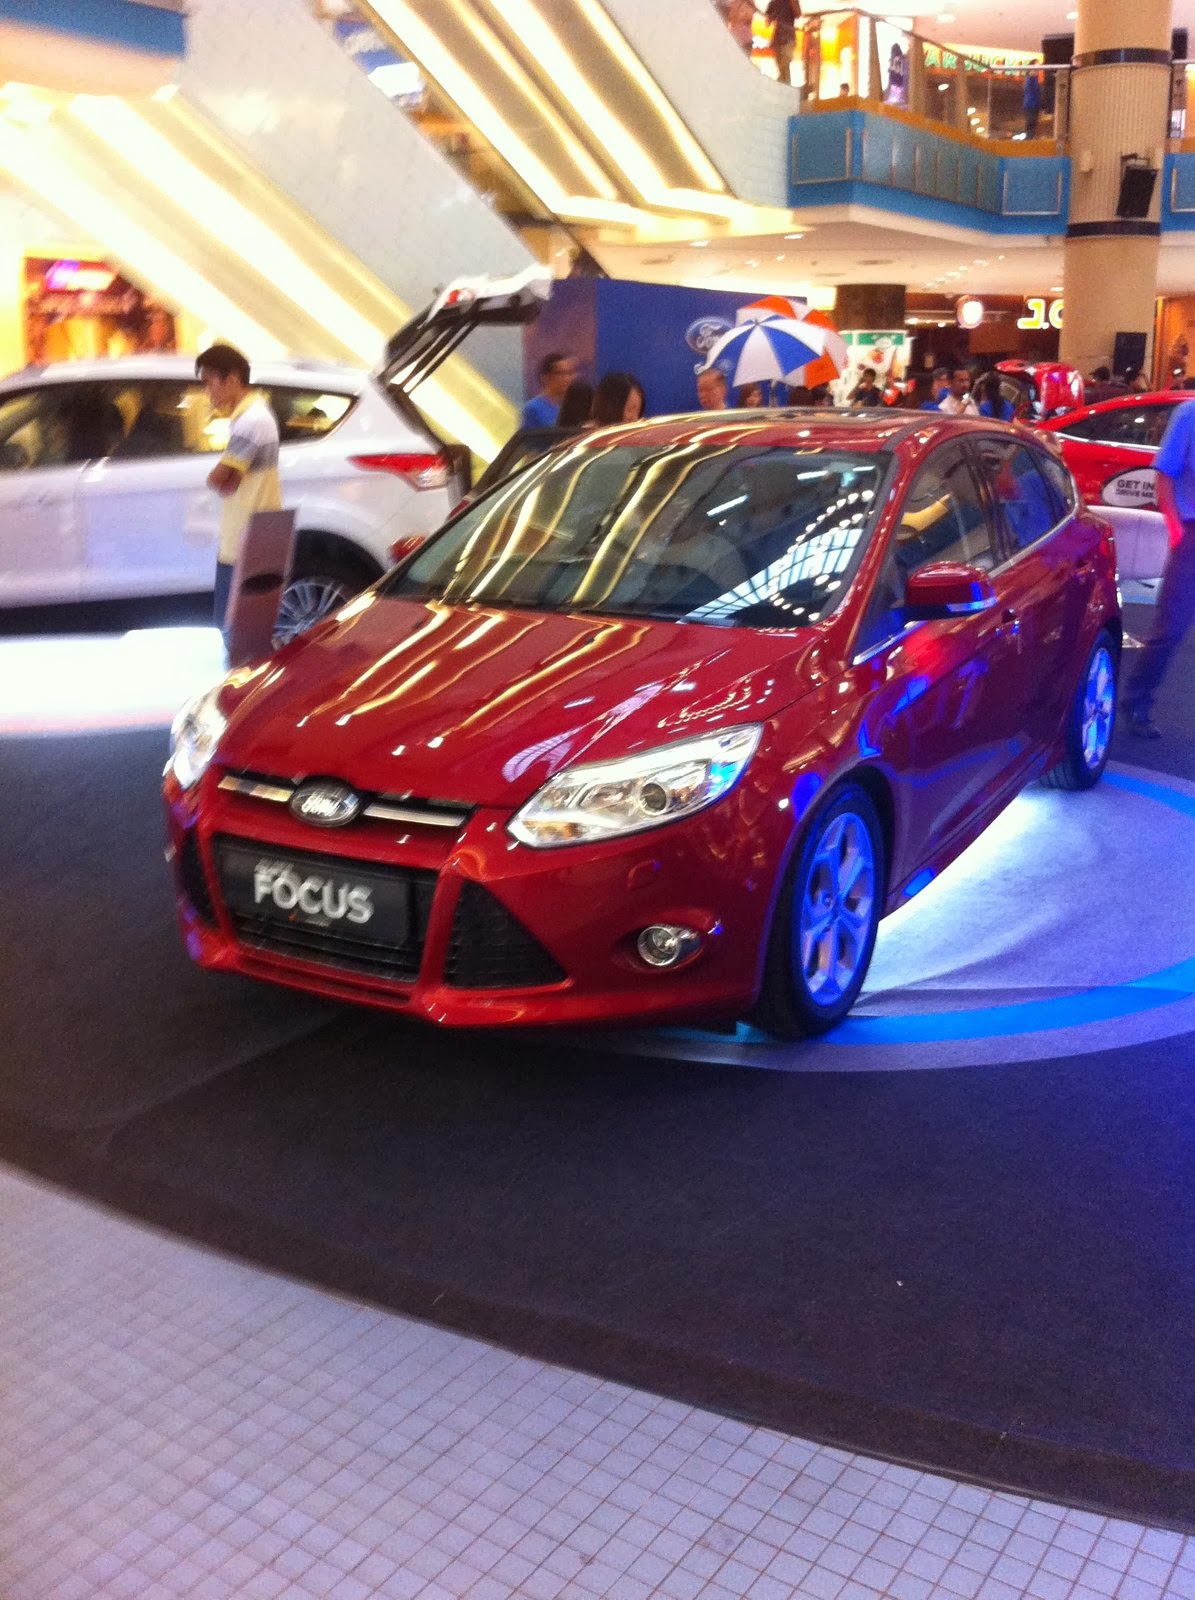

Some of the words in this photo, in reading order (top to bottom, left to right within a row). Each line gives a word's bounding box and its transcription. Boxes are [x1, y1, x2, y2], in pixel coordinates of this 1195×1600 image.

[1117, 479, 1140, 489] GET
[1142, 482, 1155, 491] IN
[1115, 488, 1140, 497] DRIVE
[254, 863, 374, 924] FOCUS
